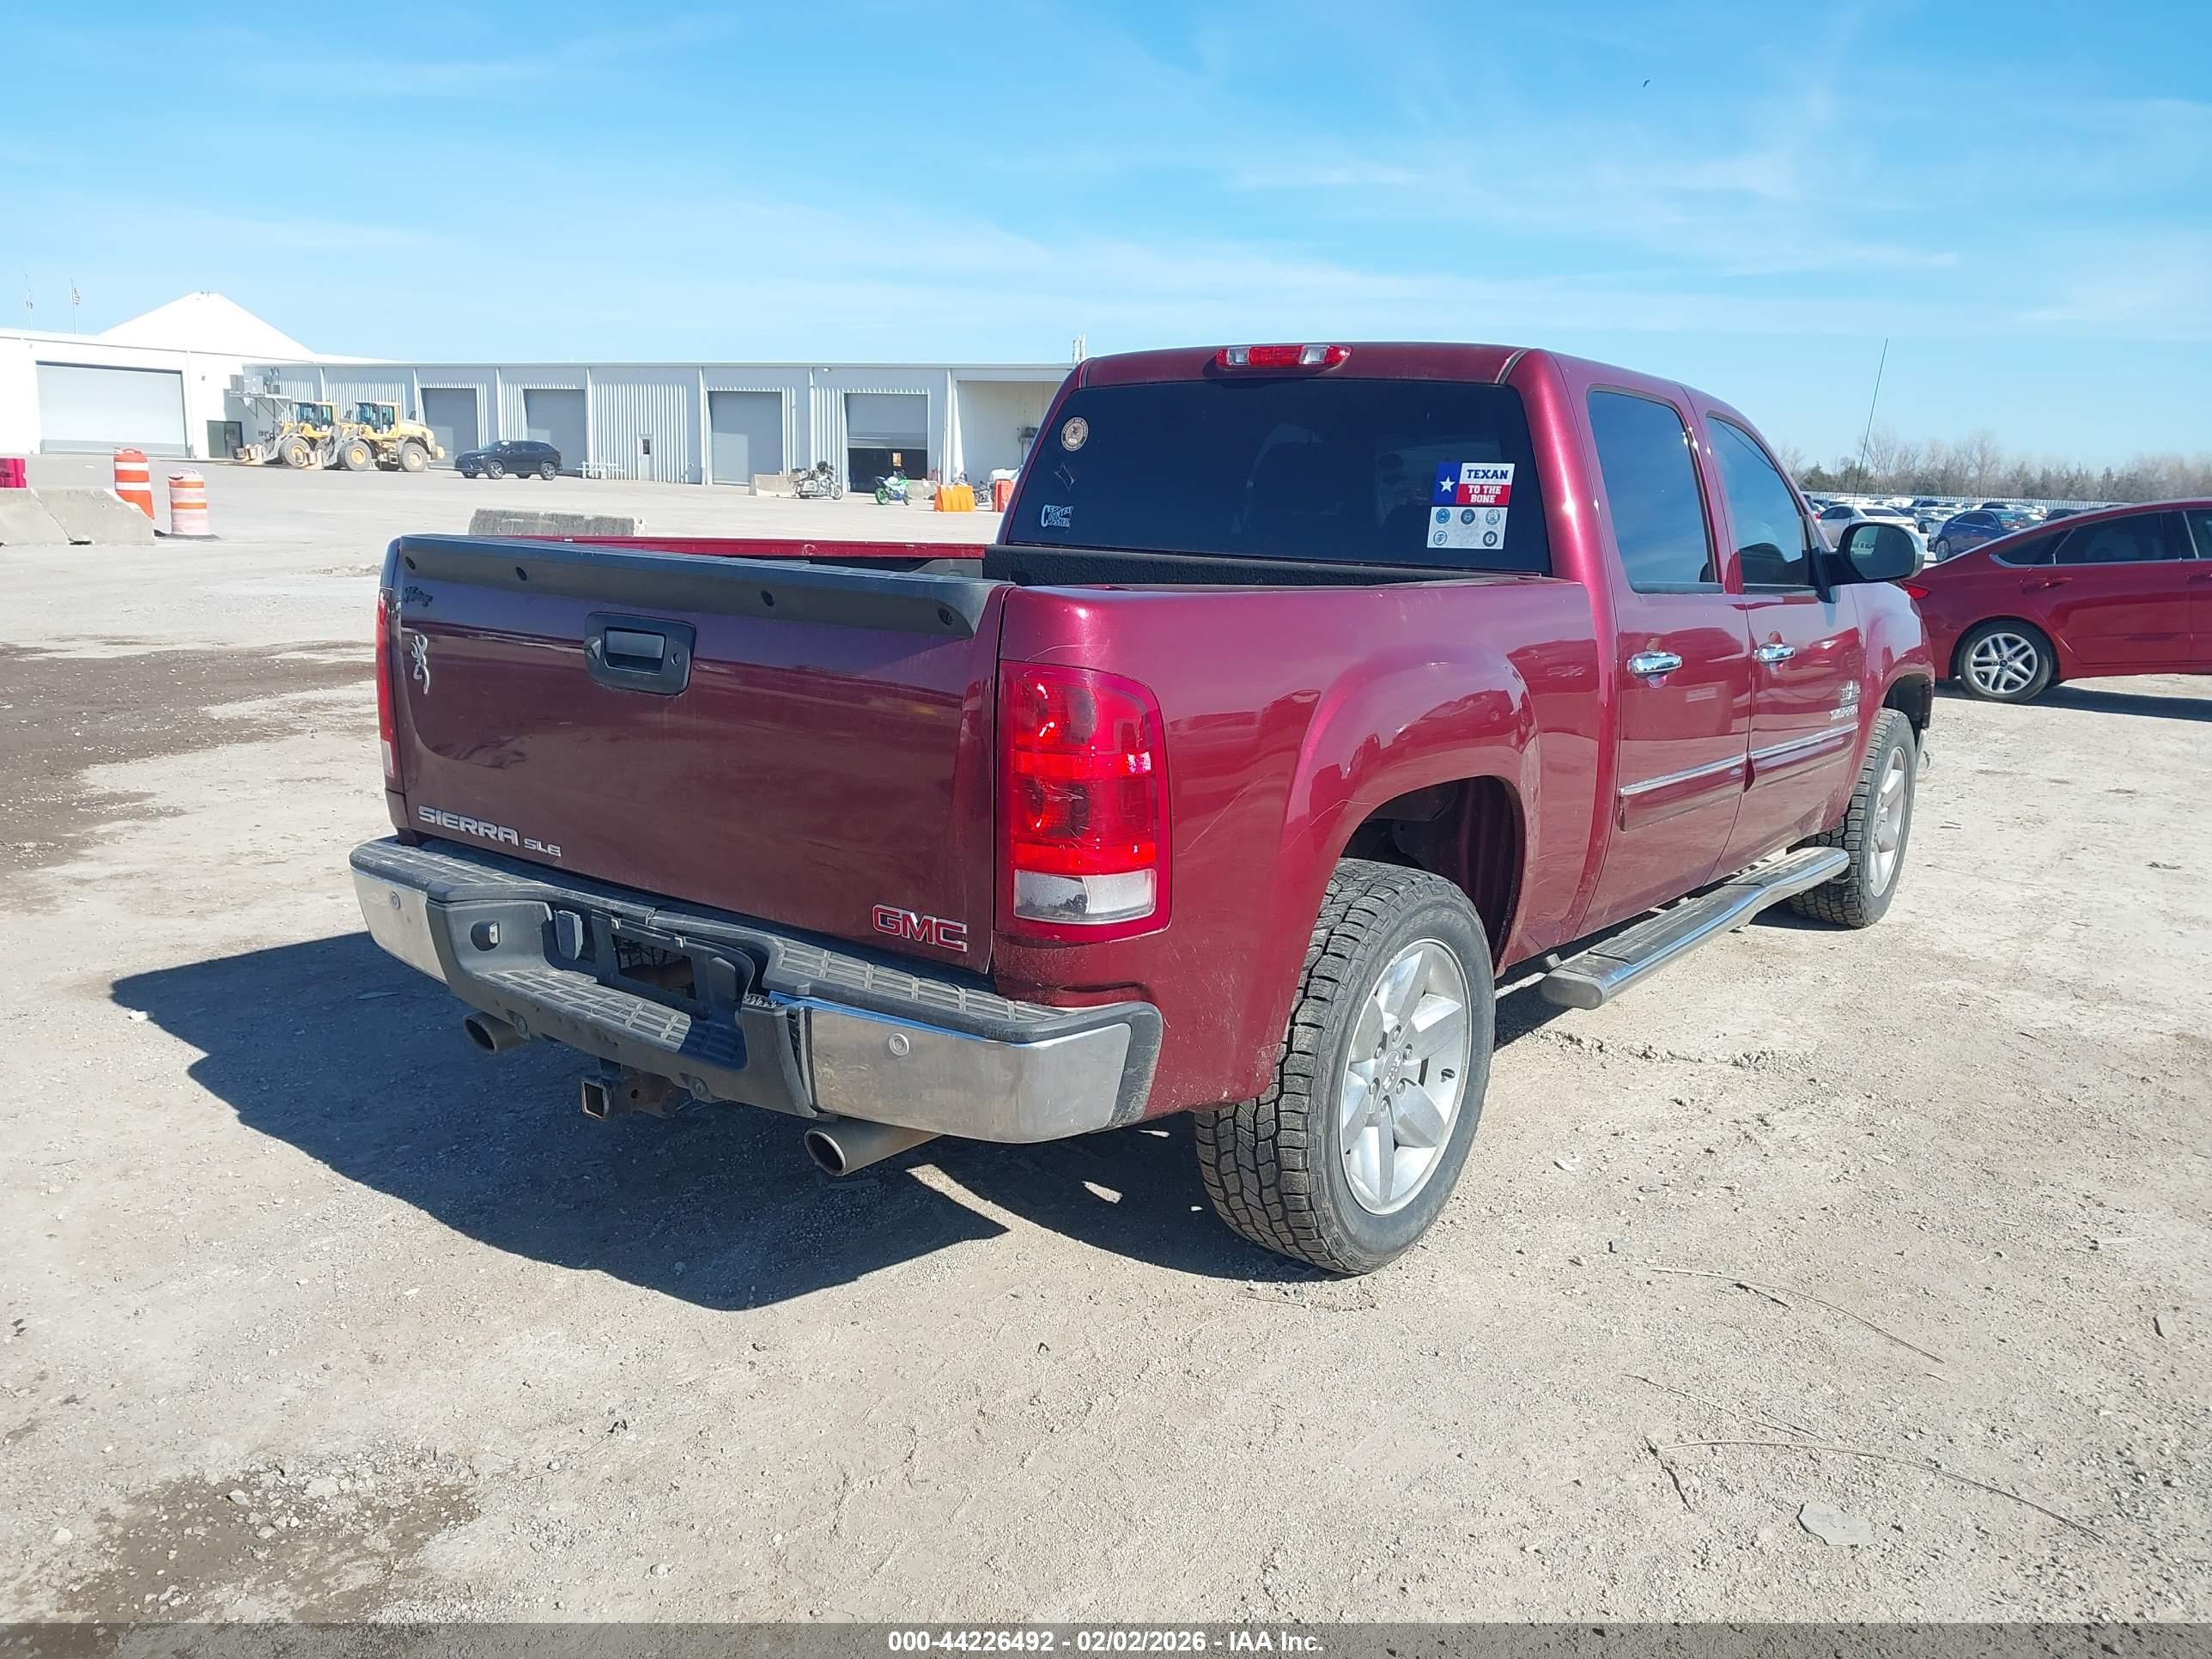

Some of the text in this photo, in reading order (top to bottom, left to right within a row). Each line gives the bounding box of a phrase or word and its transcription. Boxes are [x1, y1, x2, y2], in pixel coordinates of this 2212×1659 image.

[1467, 469, 1509, 479] TEXAN
[1468, 485, 1502, 495] TO THE
[1470, 495, 1496, 503] BONE
[418, 805, 561, 857] SIERRA SLE
[872, 904, 967, 952] GMC
